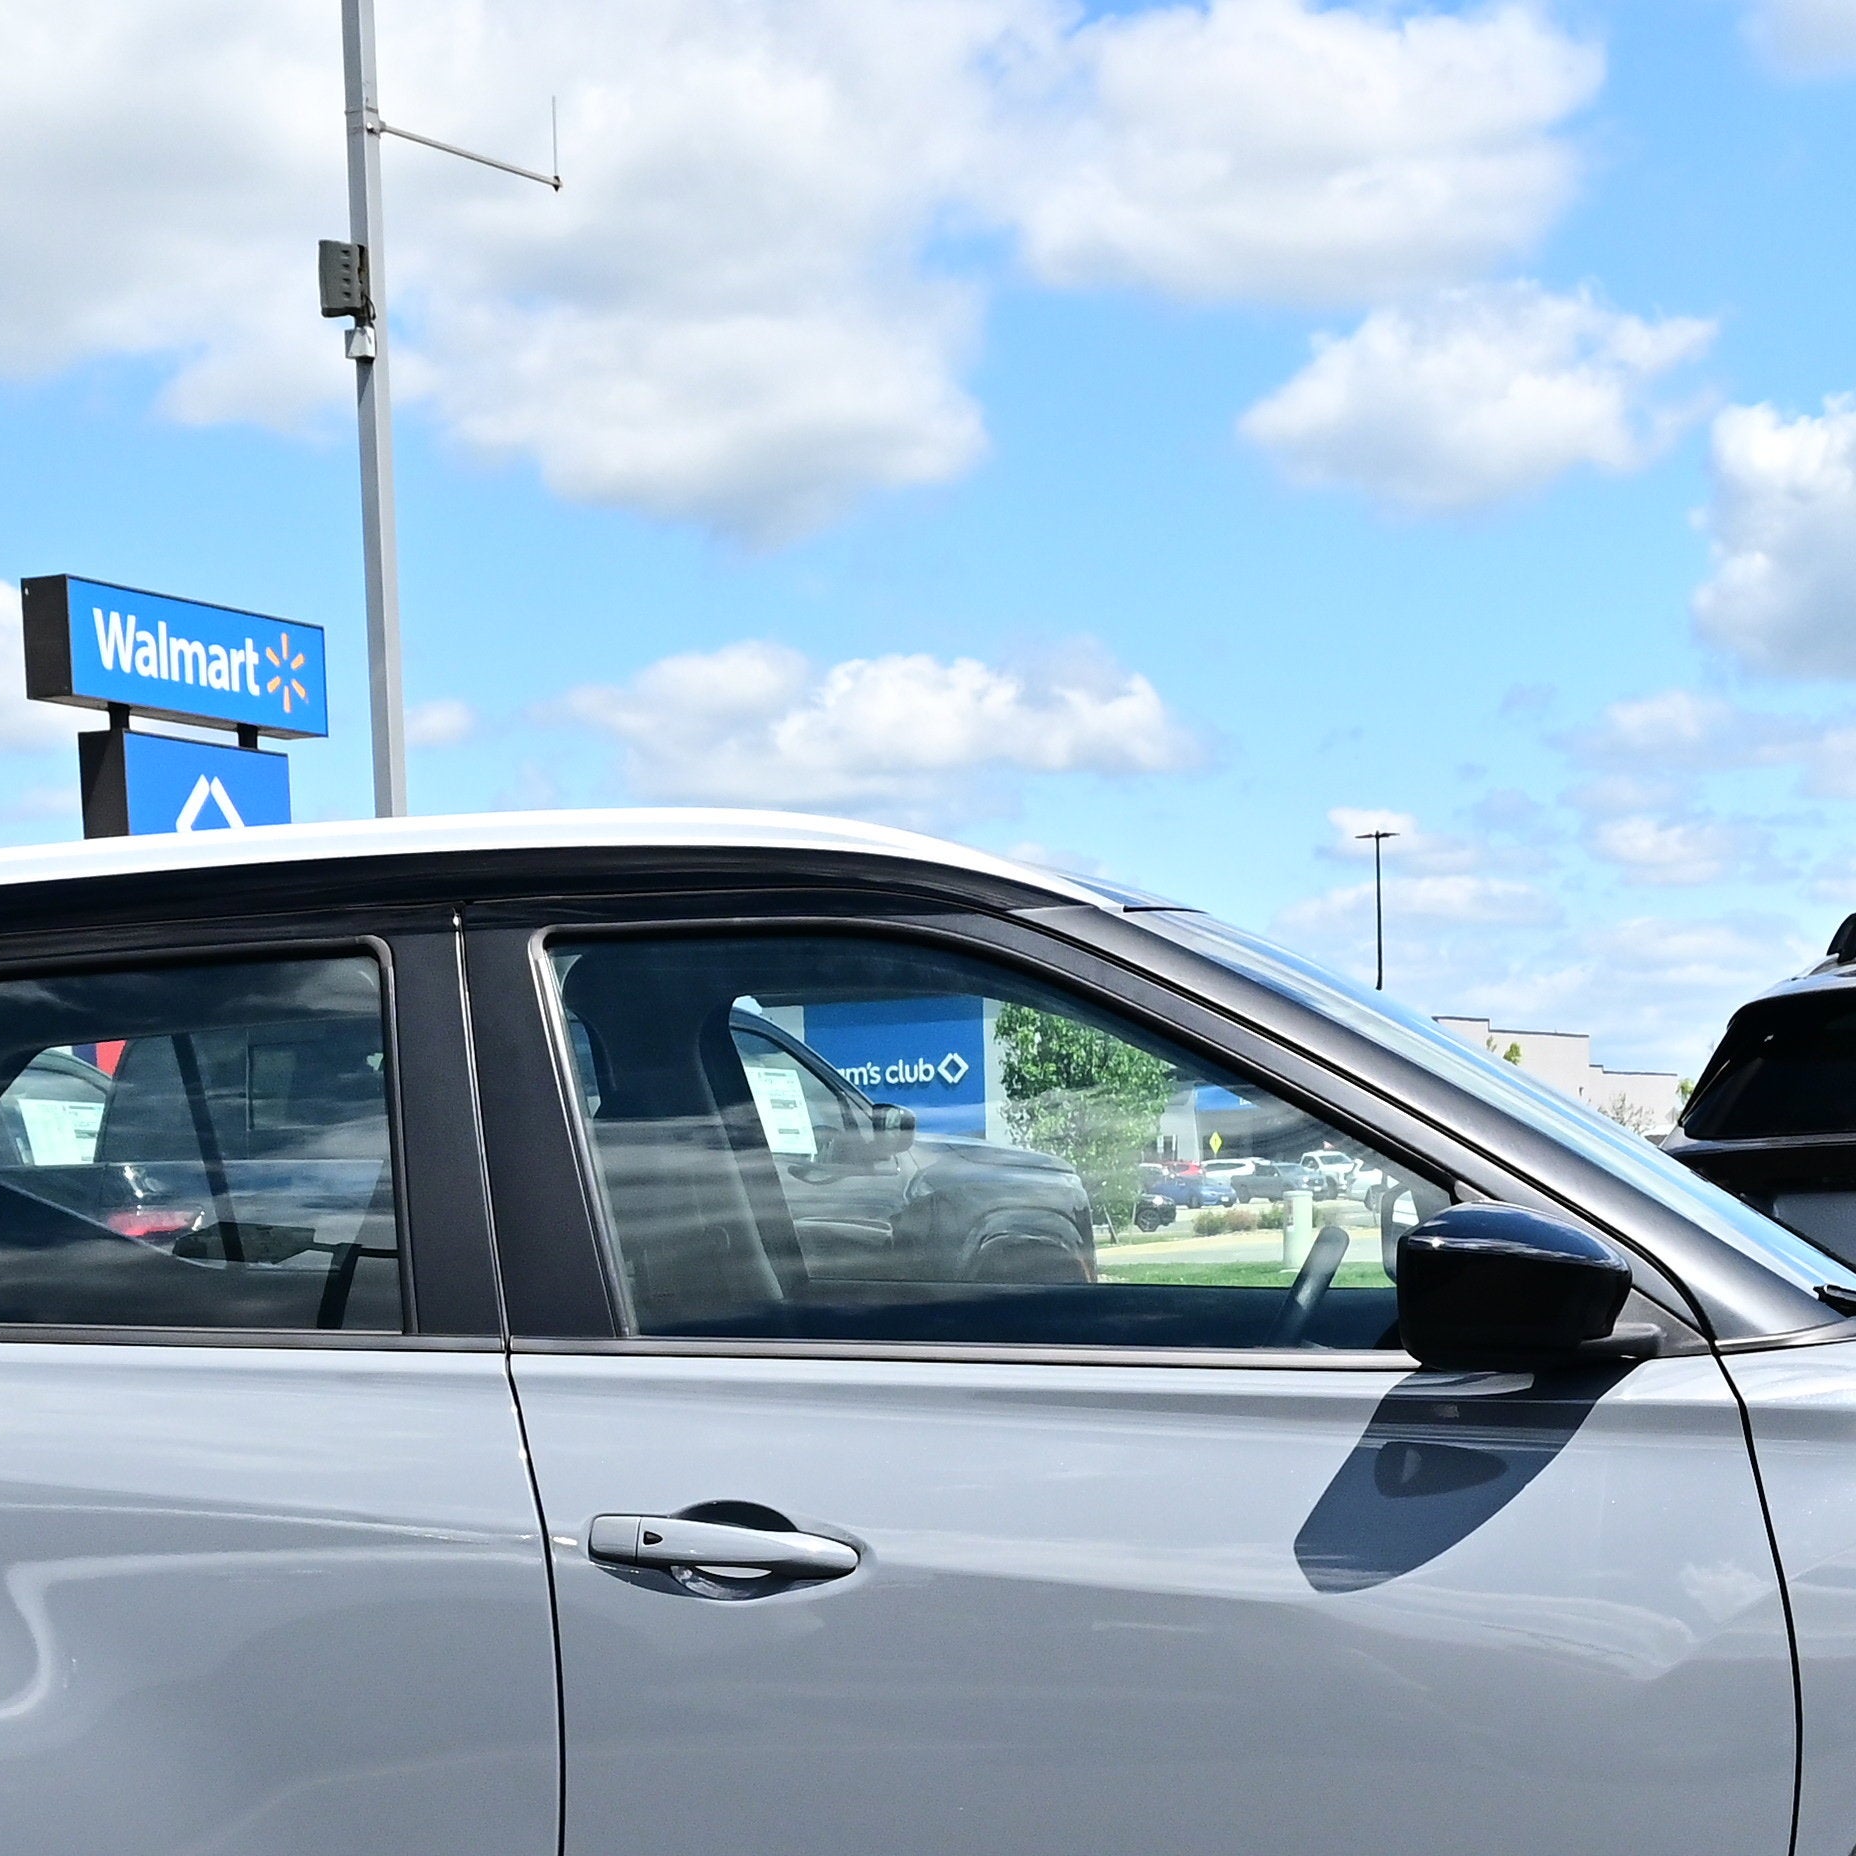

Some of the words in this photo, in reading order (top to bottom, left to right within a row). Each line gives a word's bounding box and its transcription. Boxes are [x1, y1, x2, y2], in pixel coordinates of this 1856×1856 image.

[92, 607, 261, 696] Walmart
[836, 1061, 882, 1086] m's
[885, 1058, 935, 1085] club
